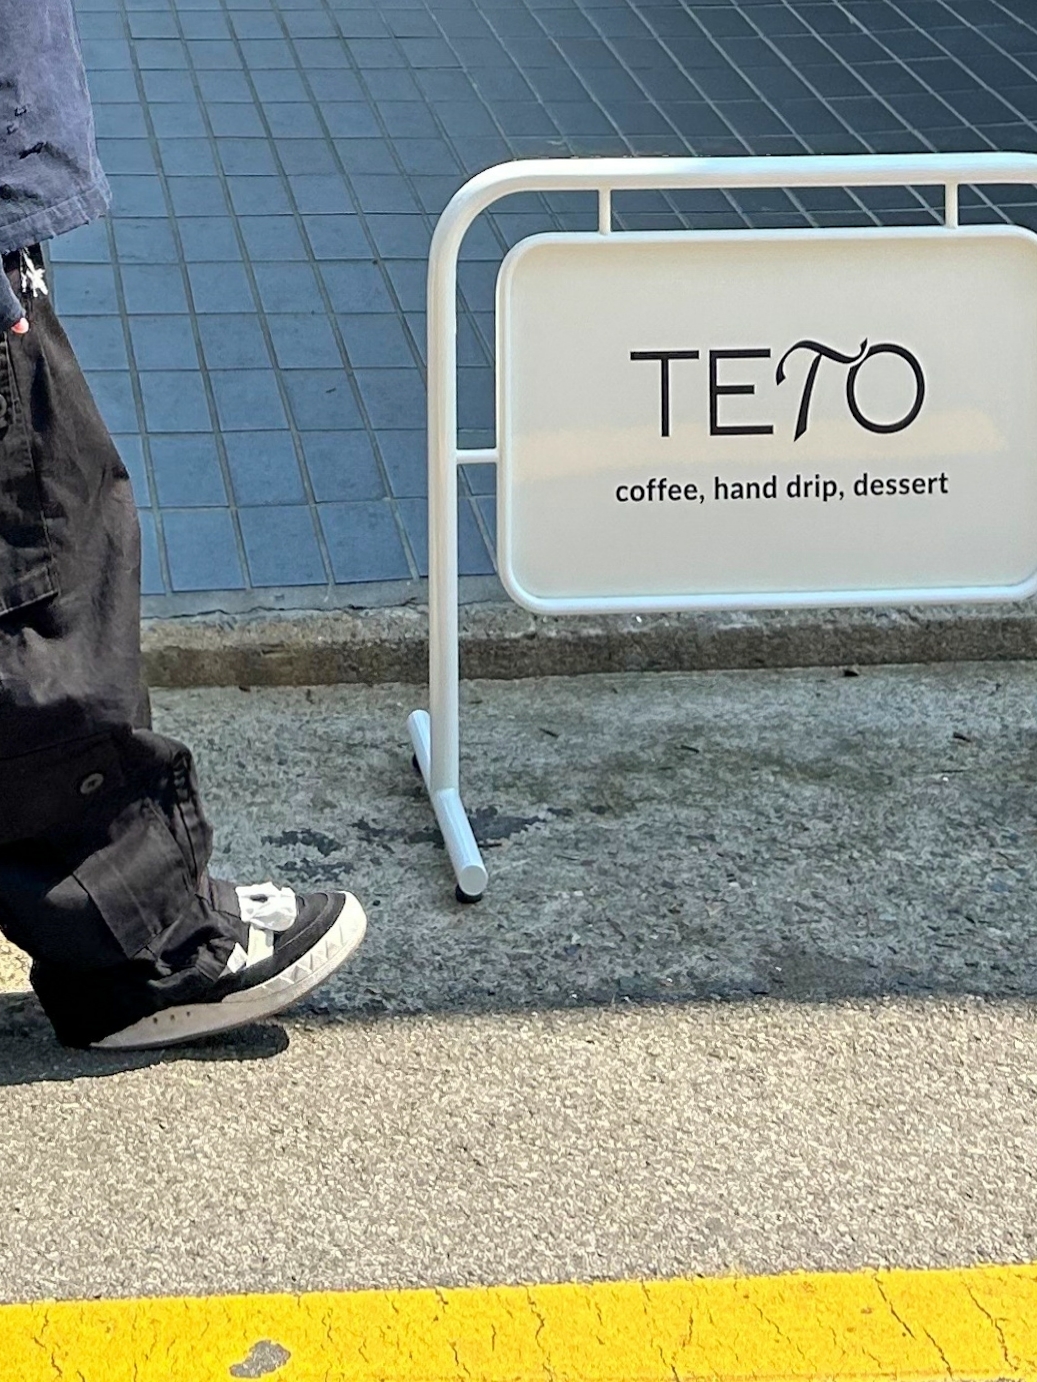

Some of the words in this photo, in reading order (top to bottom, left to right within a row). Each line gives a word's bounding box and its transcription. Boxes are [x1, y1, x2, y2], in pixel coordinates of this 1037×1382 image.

[630, 338, 925, 442] TETO
[616, 477, 705, 504] coffee,
[714, 475, 777, 500] hand
[786, 474, 845, 503] drip,
[853, 471, 949, 497] dessert
